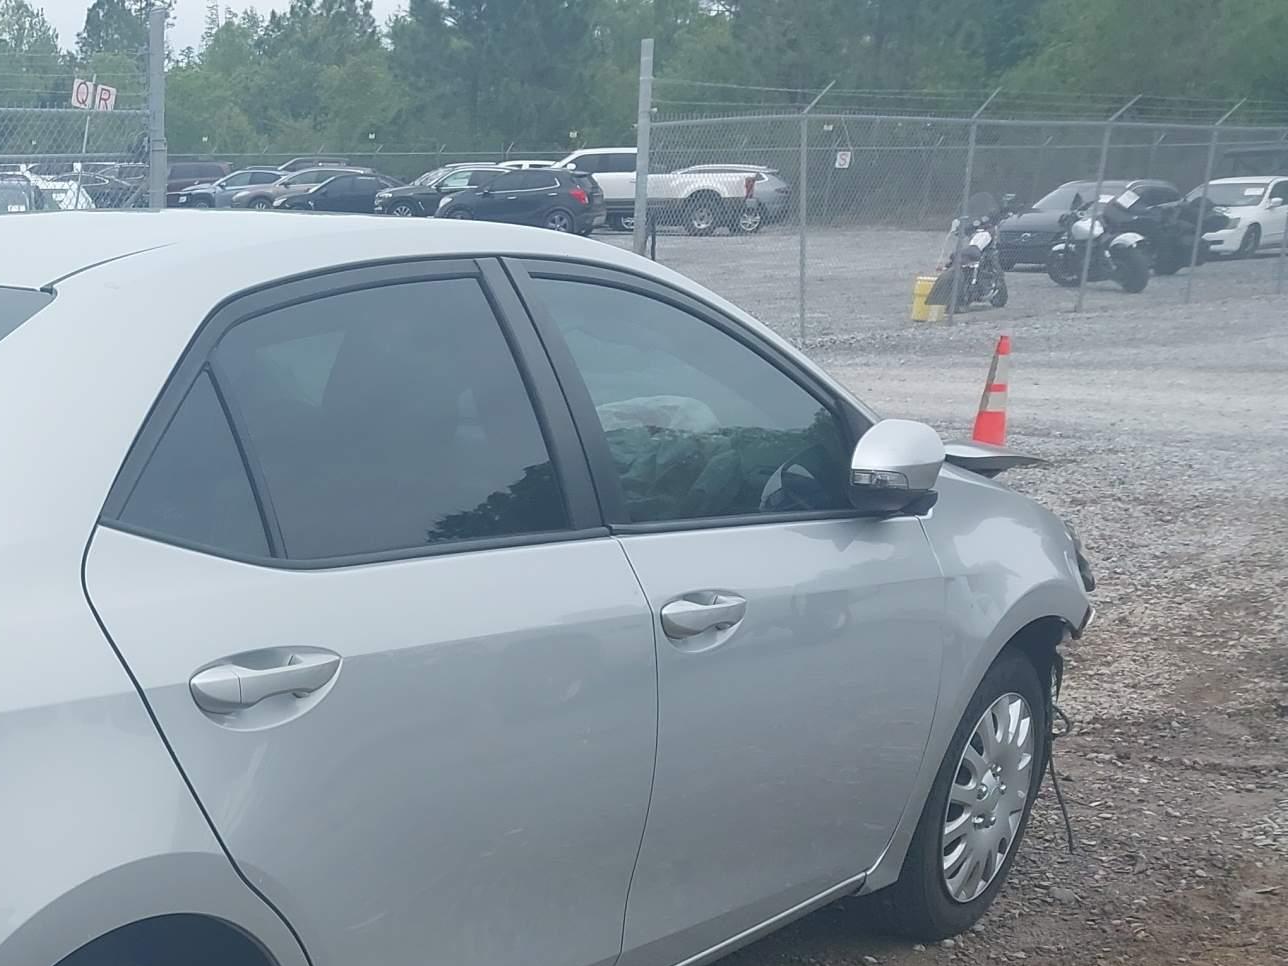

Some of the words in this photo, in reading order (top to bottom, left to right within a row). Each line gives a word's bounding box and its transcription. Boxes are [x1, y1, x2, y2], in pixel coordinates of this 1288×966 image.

[76, 81, 88, 106] Q
[98, 87, 111, 110] R
[839, 153, 849, 167] S
